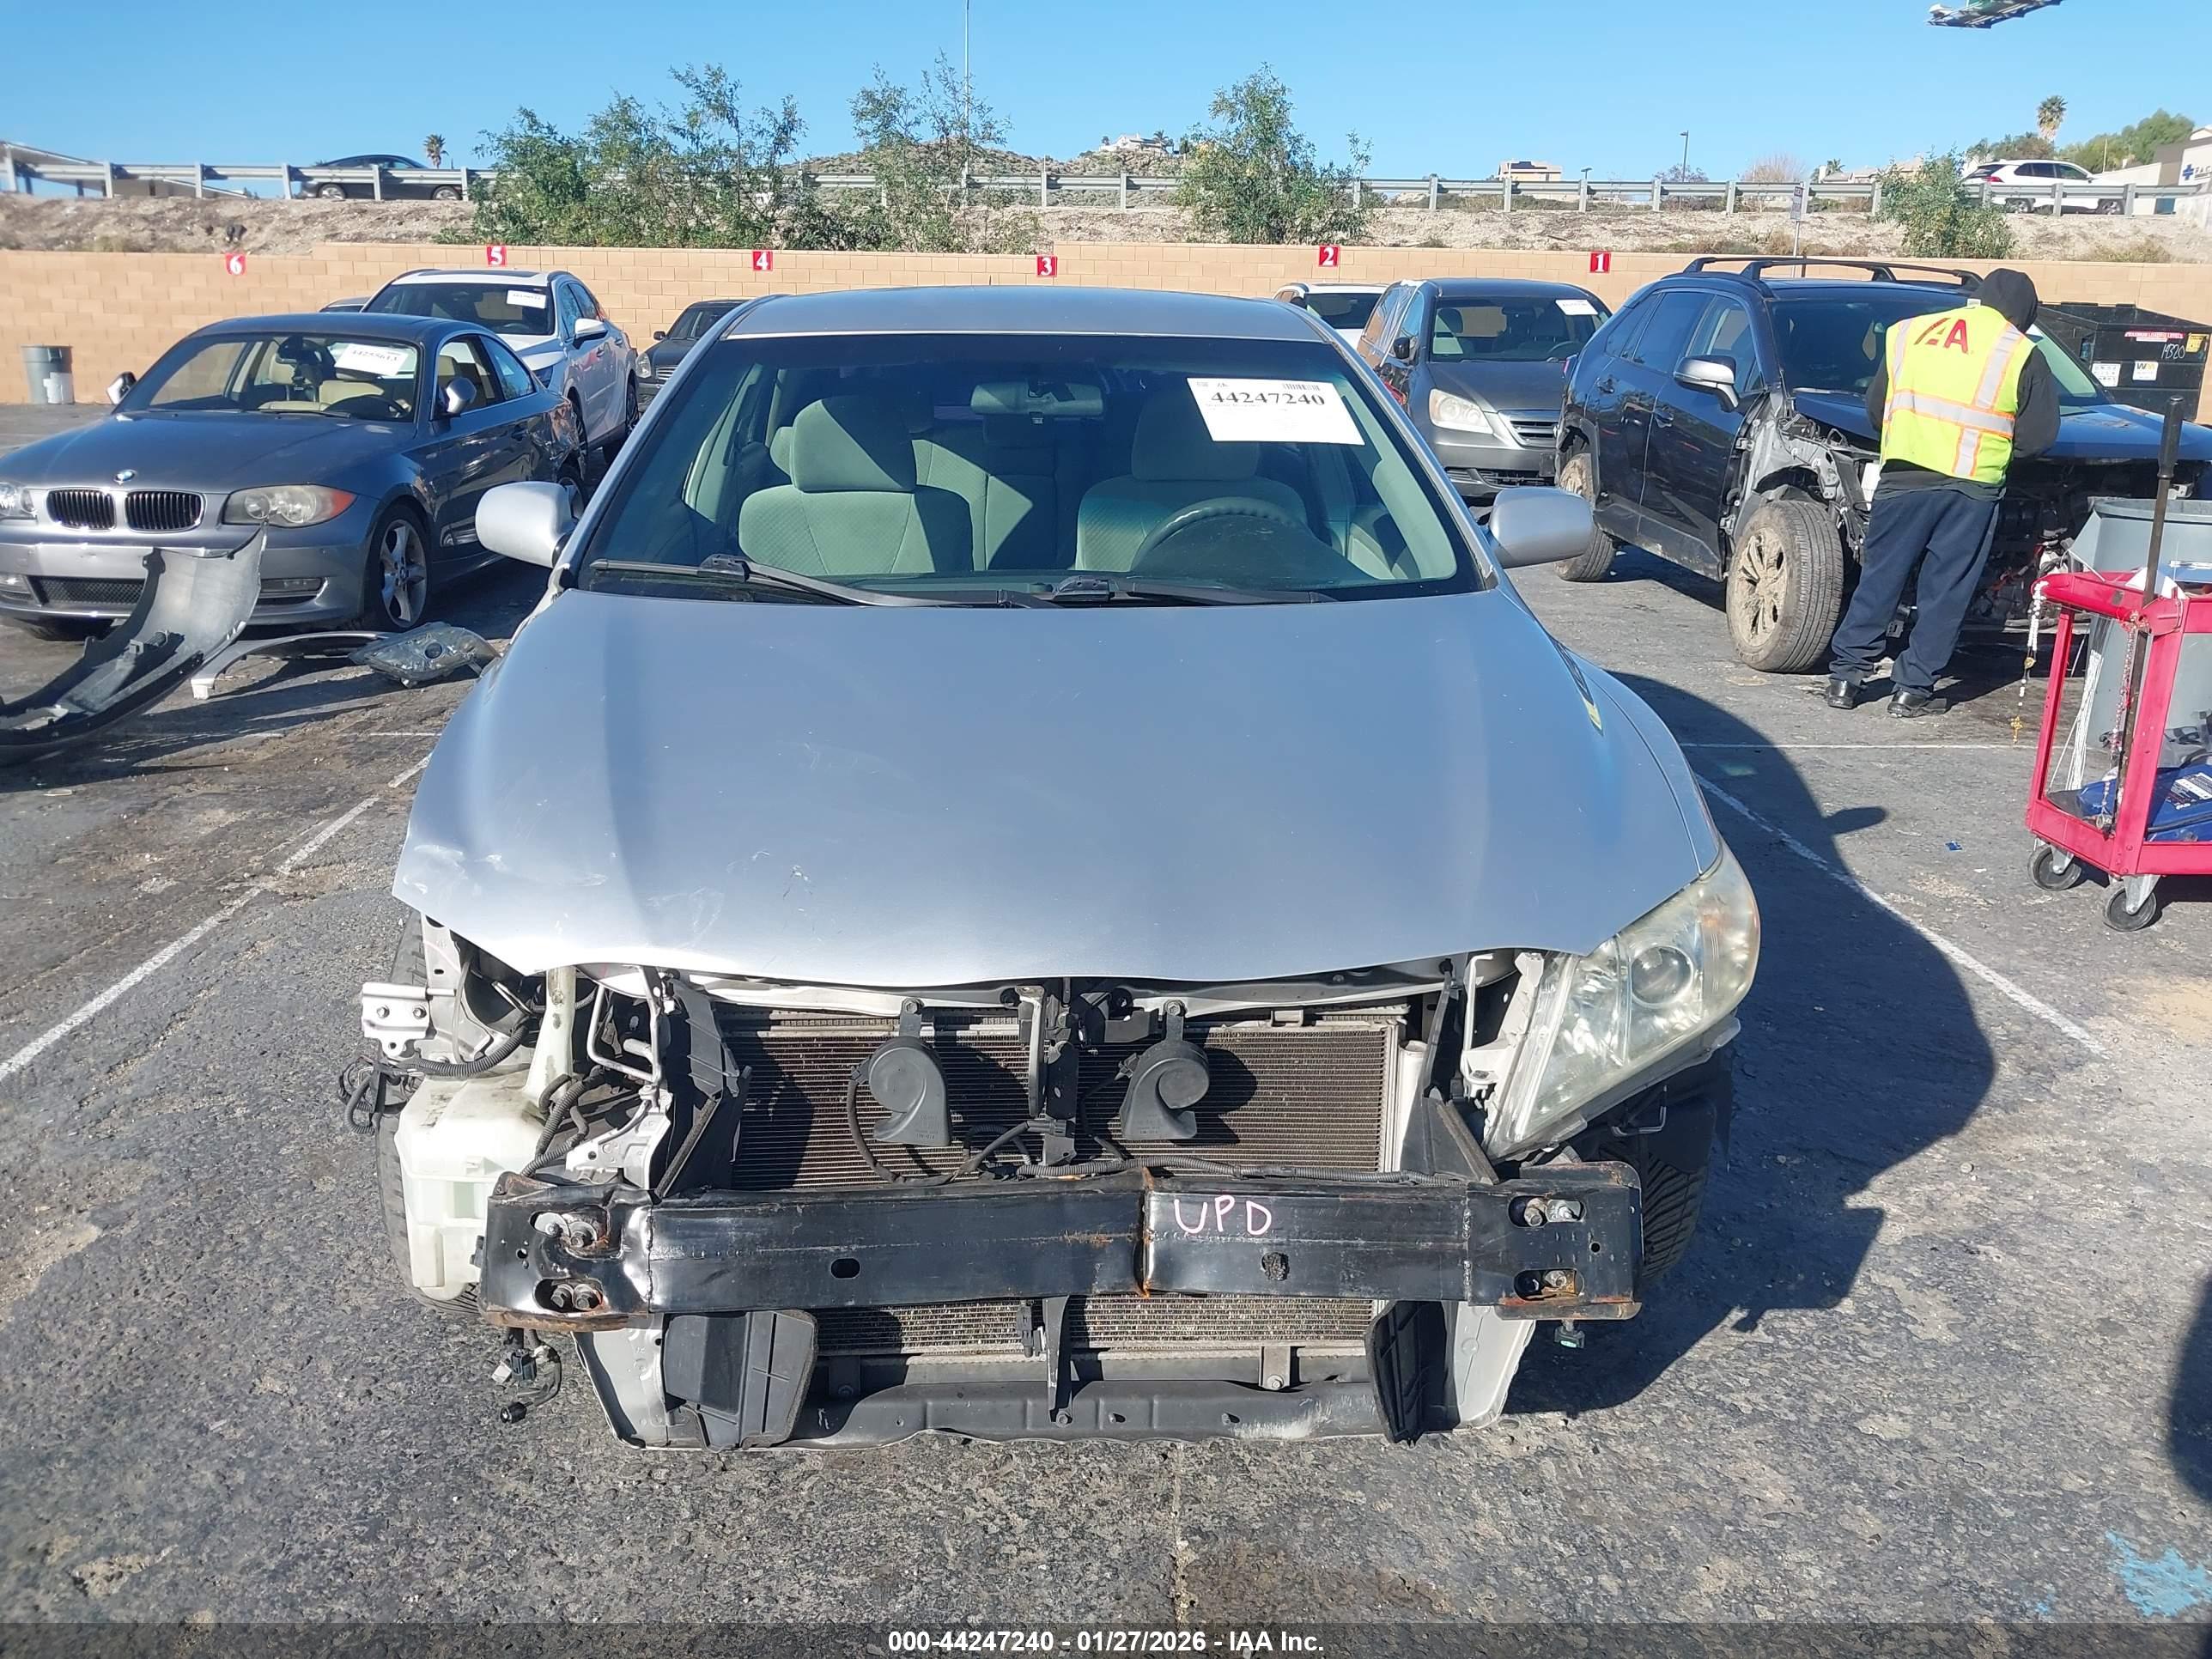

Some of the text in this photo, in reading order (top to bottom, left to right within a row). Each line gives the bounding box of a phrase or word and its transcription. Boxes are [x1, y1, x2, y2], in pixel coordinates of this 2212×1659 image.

[490, 246, 503, 264] 5
[756, 252, 769, 270] 4
[1322, 247, 1334, 266] 2
[1595, 253, 1606, 272] 1
[229, 256, 242, 275] 6
[1040, 257, 1053, 276] 3
[1211, 392, 1325, 406] 44247240
[1174, 1194, 1272, 1236] UPD
